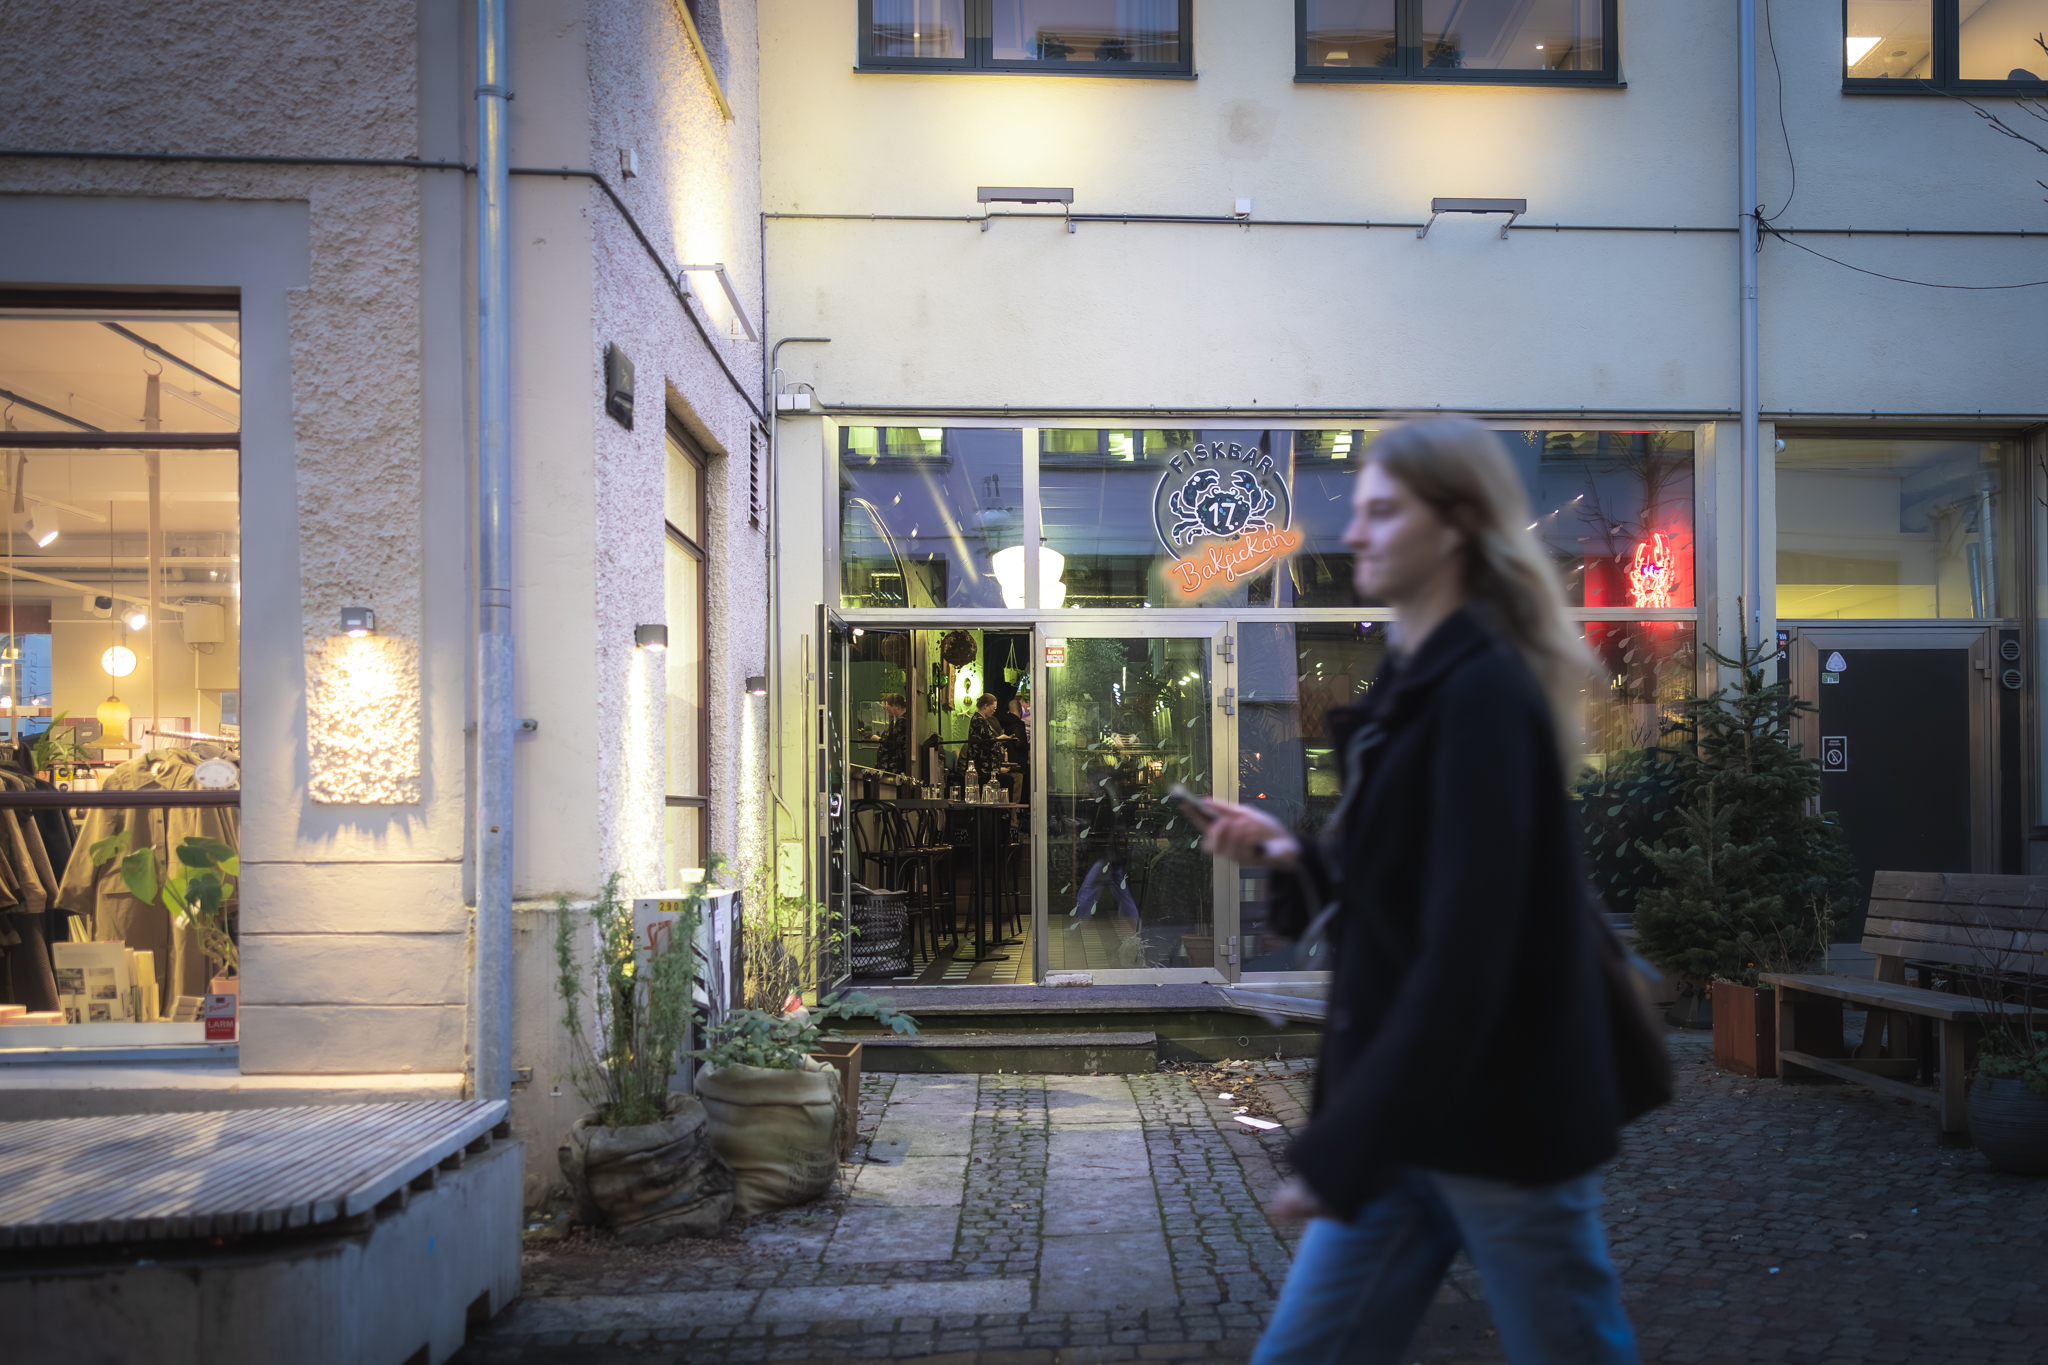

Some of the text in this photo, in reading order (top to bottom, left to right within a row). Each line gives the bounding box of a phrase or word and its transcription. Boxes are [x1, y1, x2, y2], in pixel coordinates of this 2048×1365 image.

[1168, 441, 1274, 475] FISKBAR
[1208, 502, 1236, 527] 17
[1173, 534, 1295, 592] Bakfickan
[659, 902, 687, 911] 290
[208, 1020, 233, 1028] LARM
